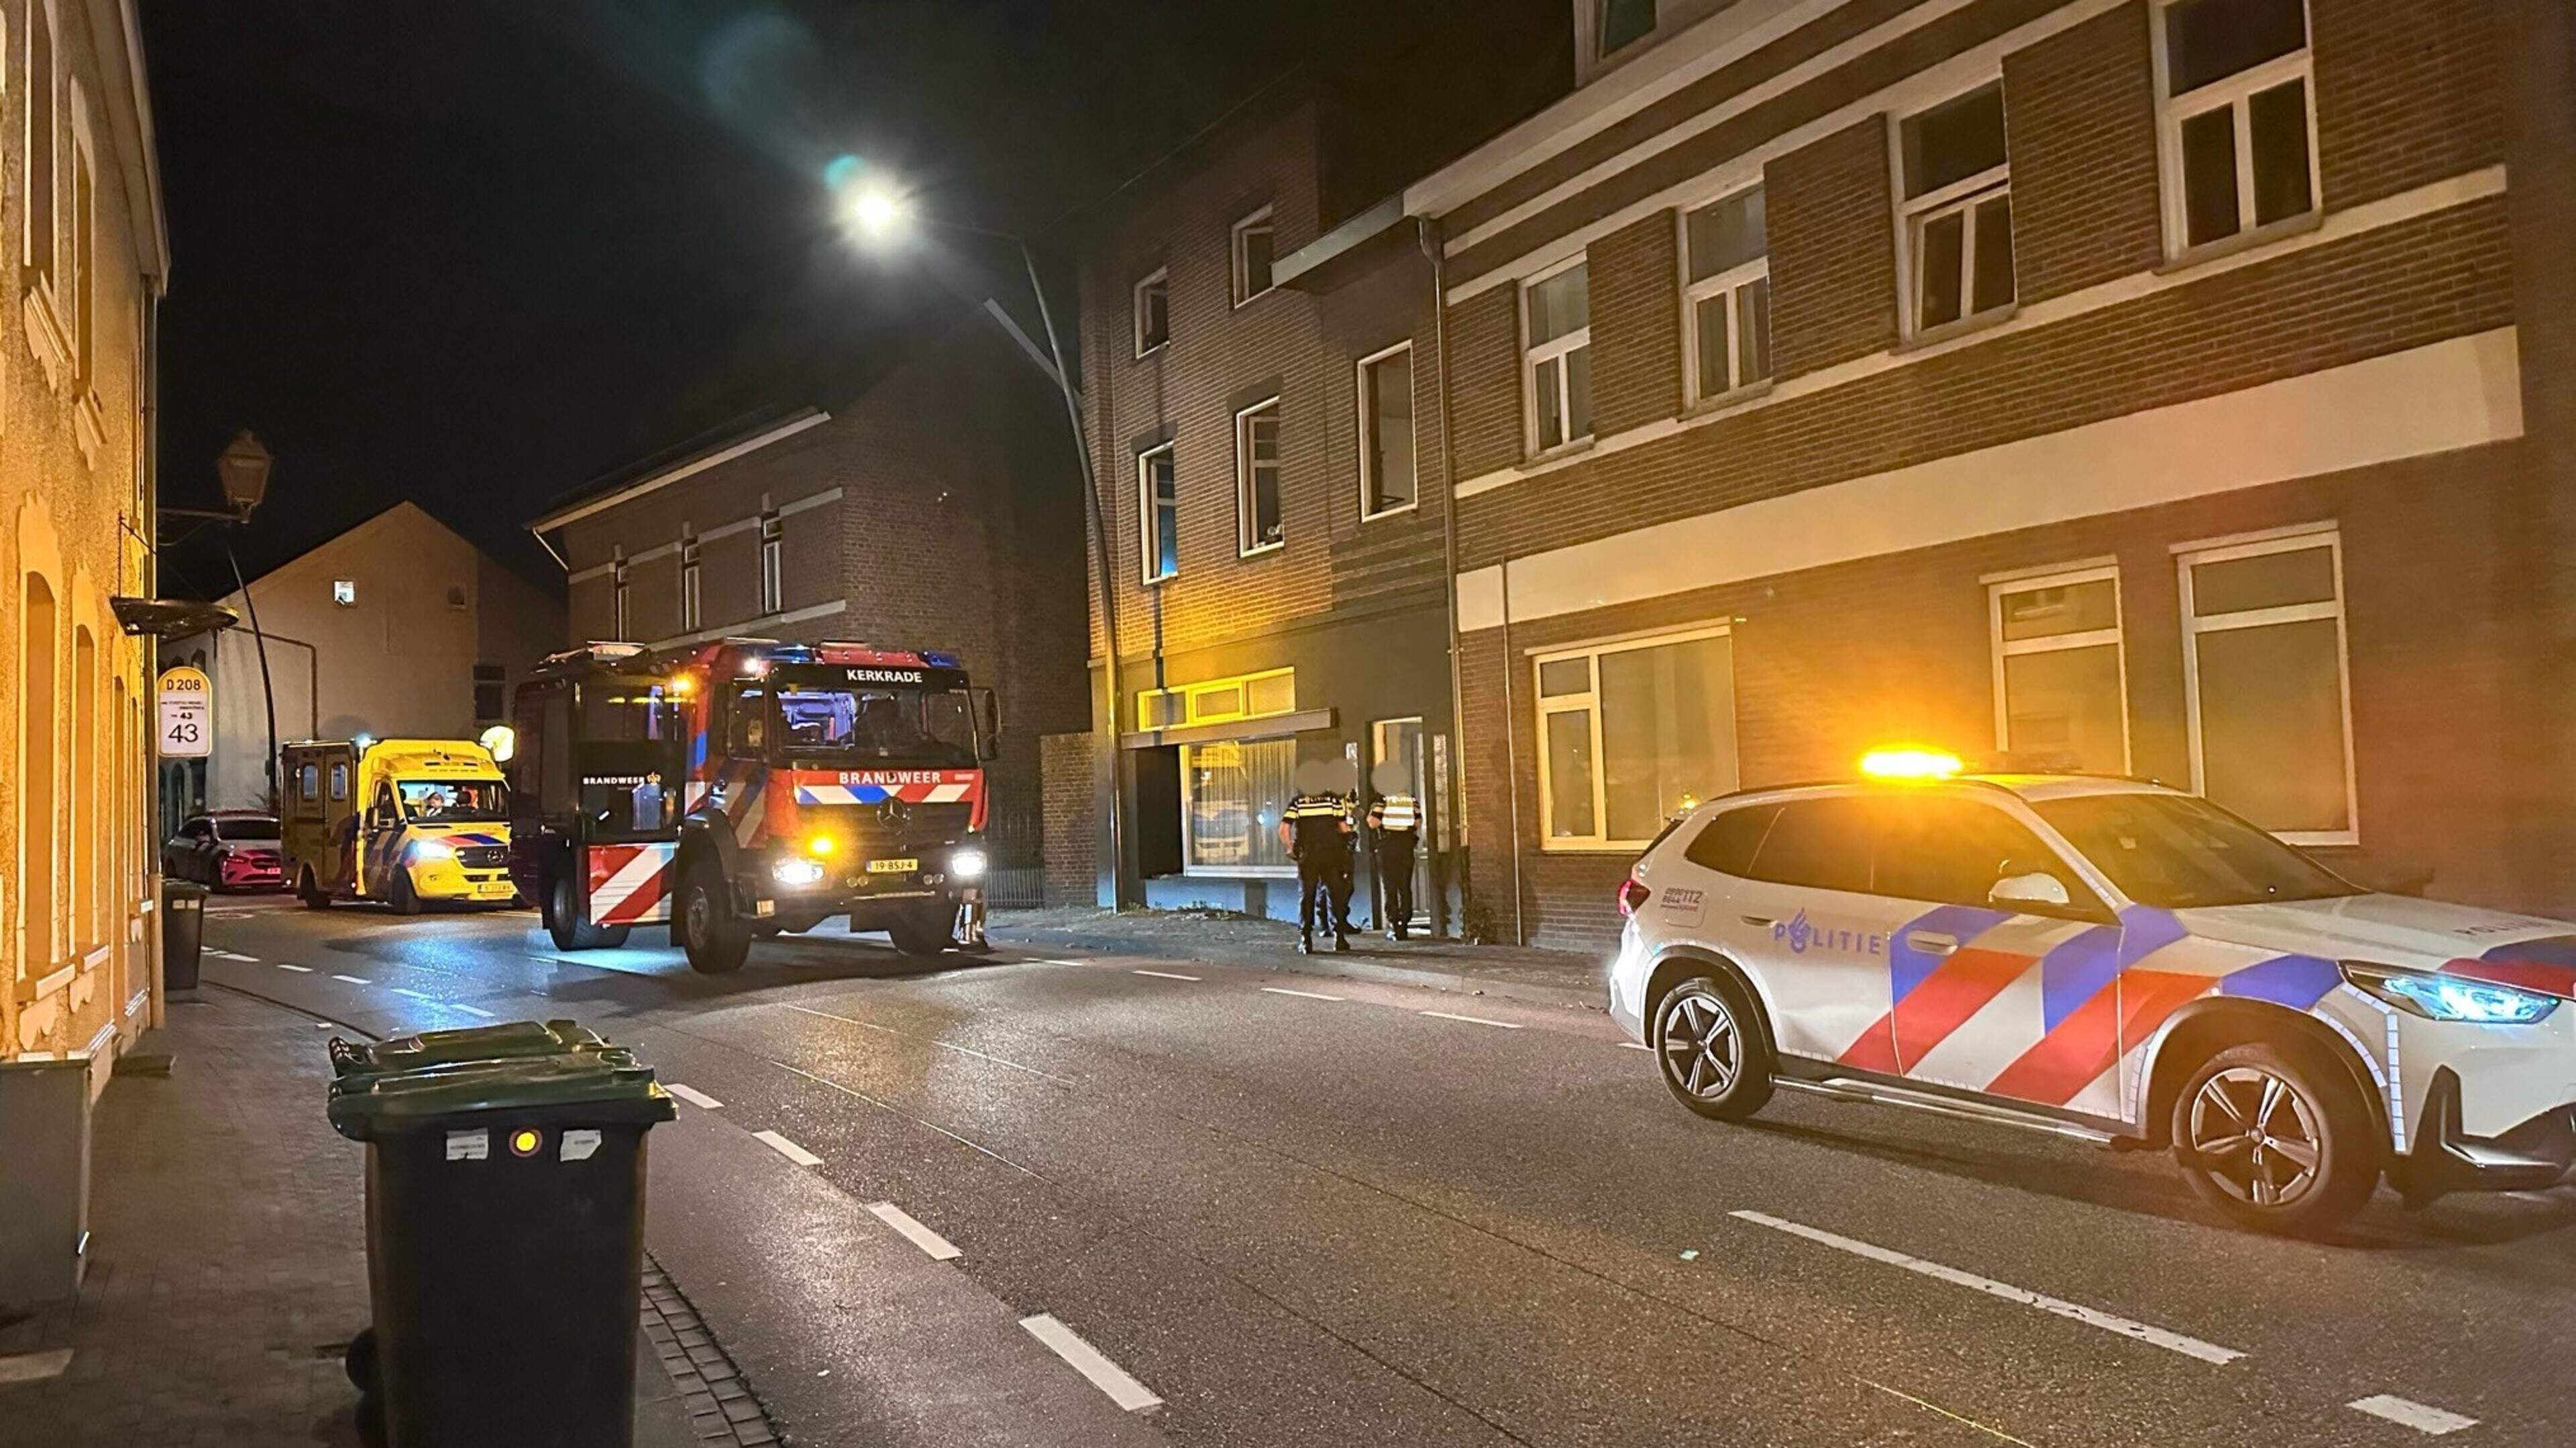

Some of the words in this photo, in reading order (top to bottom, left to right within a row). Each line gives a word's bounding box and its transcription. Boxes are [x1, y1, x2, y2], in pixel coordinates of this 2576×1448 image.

[846, 669, 923, 683] KERKRADE
[167, 679, 174, 690] D
[176, 679, 201, 691] 208
[168, 724, 199, 743] 43
[583, 777, 645, 785] BRANDWEER
[839, 771, 941, 785] BRANDWEER
